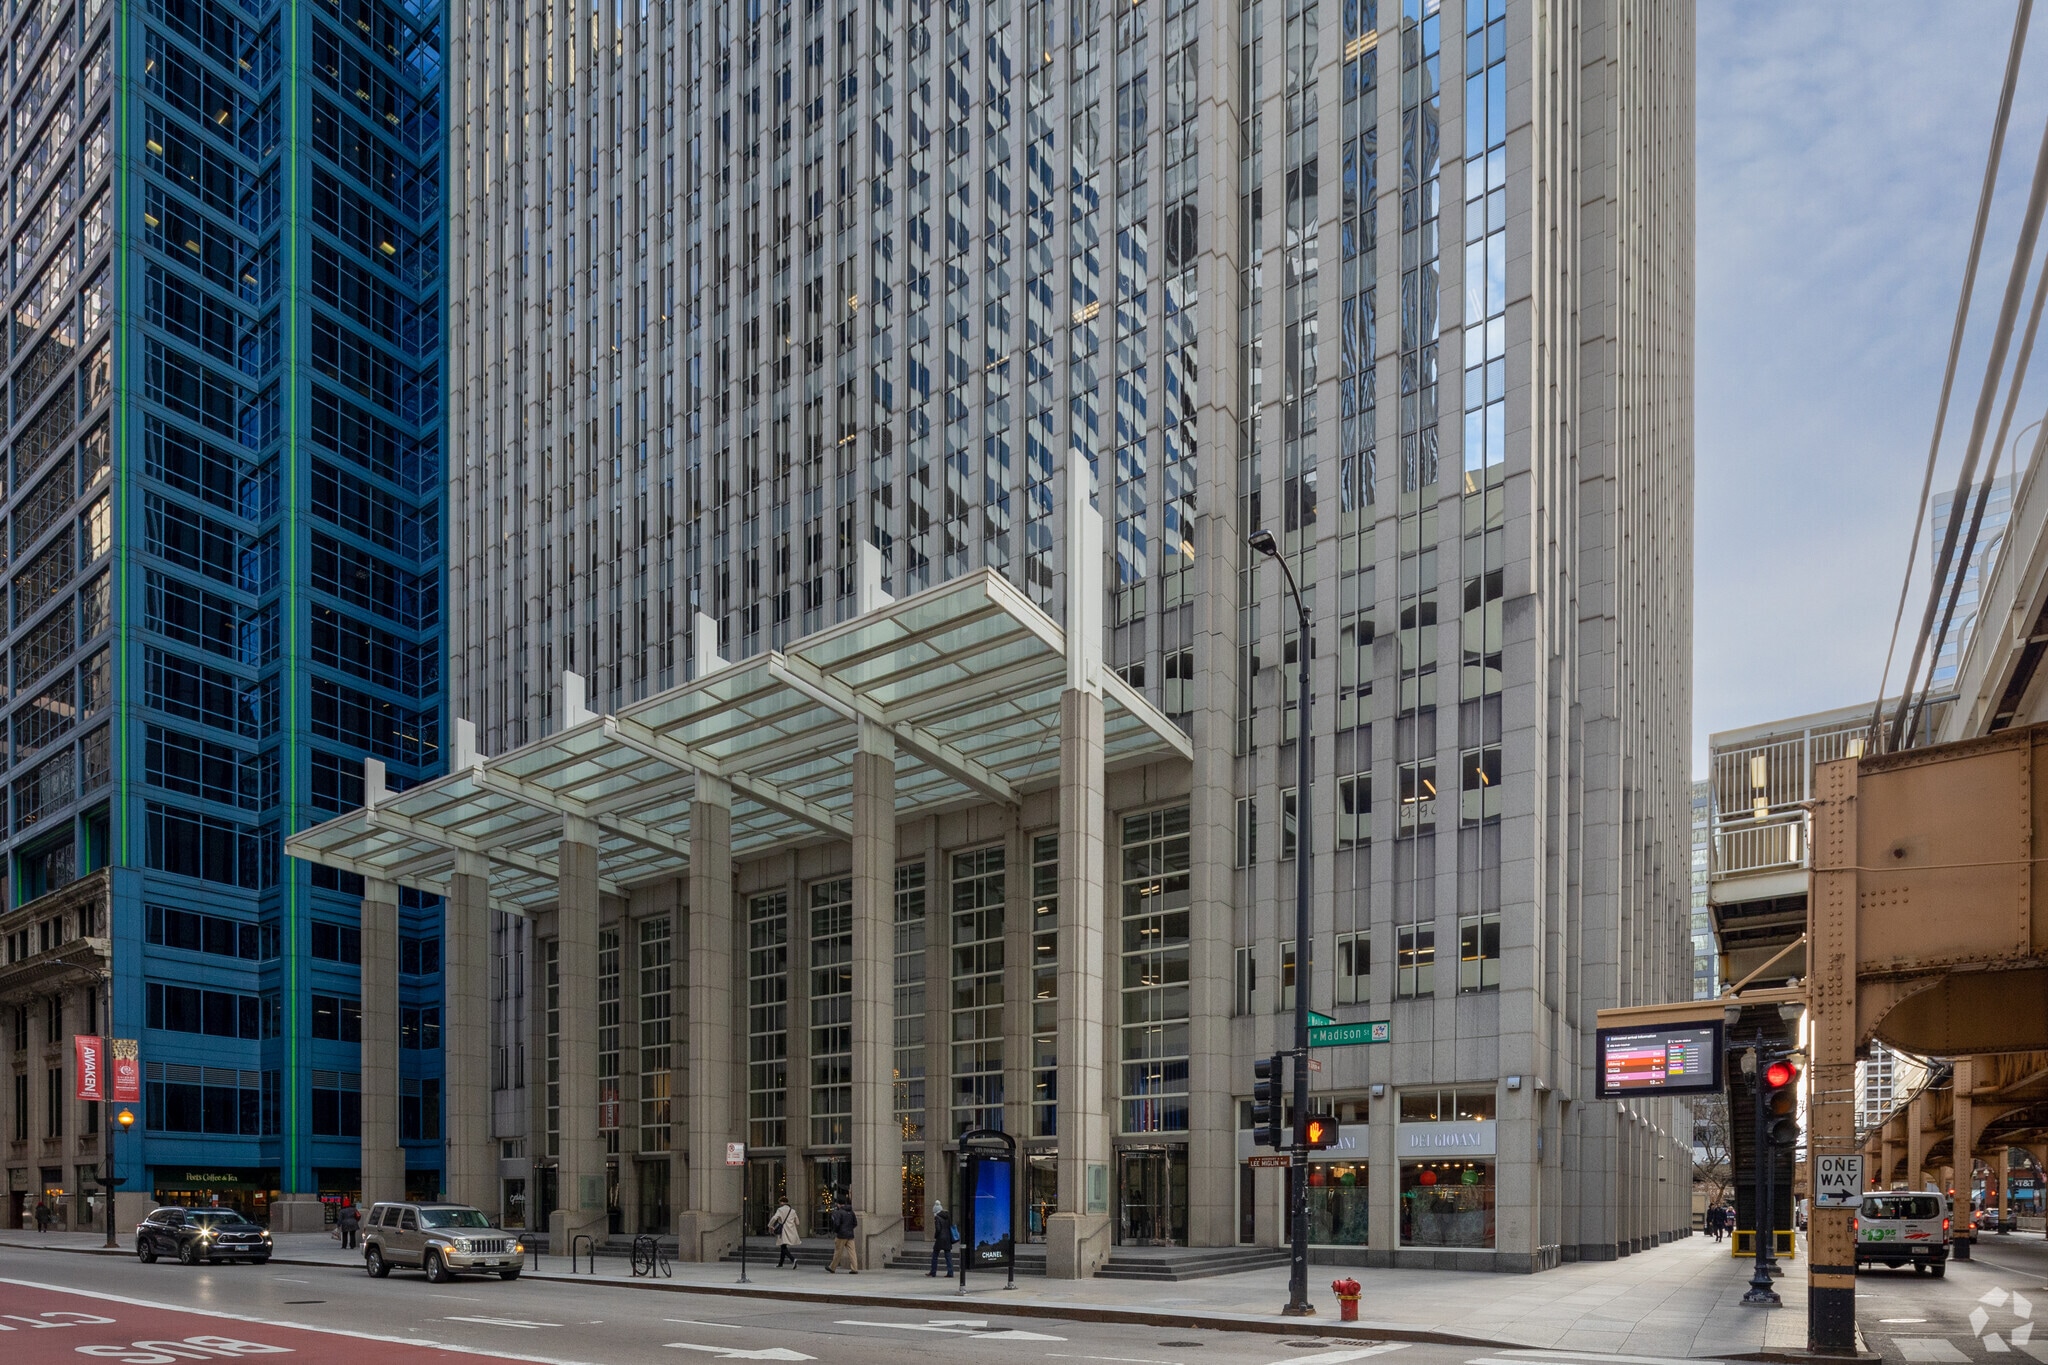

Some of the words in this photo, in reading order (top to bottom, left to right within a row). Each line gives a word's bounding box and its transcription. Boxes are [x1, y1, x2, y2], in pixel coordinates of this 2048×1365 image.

[1319, 1029, 1361, 1041] Madison
[83, 1046, 96, 1092] AWAKEN
[1411, 1134, 1430, 1147] DEI
[1434, 1132, 1481, 1147] GIOVANI
[1822, 1159, 1857, 1171] ONE
[202, 1173, 222, 1182] Coffee
[227, 1173, 238, 1182] Tea
[1821, 1174, 1858, 1186] WAY
[0, 1311, 117, 1331] CT
[74, 1335, 297, 1364] BUS
